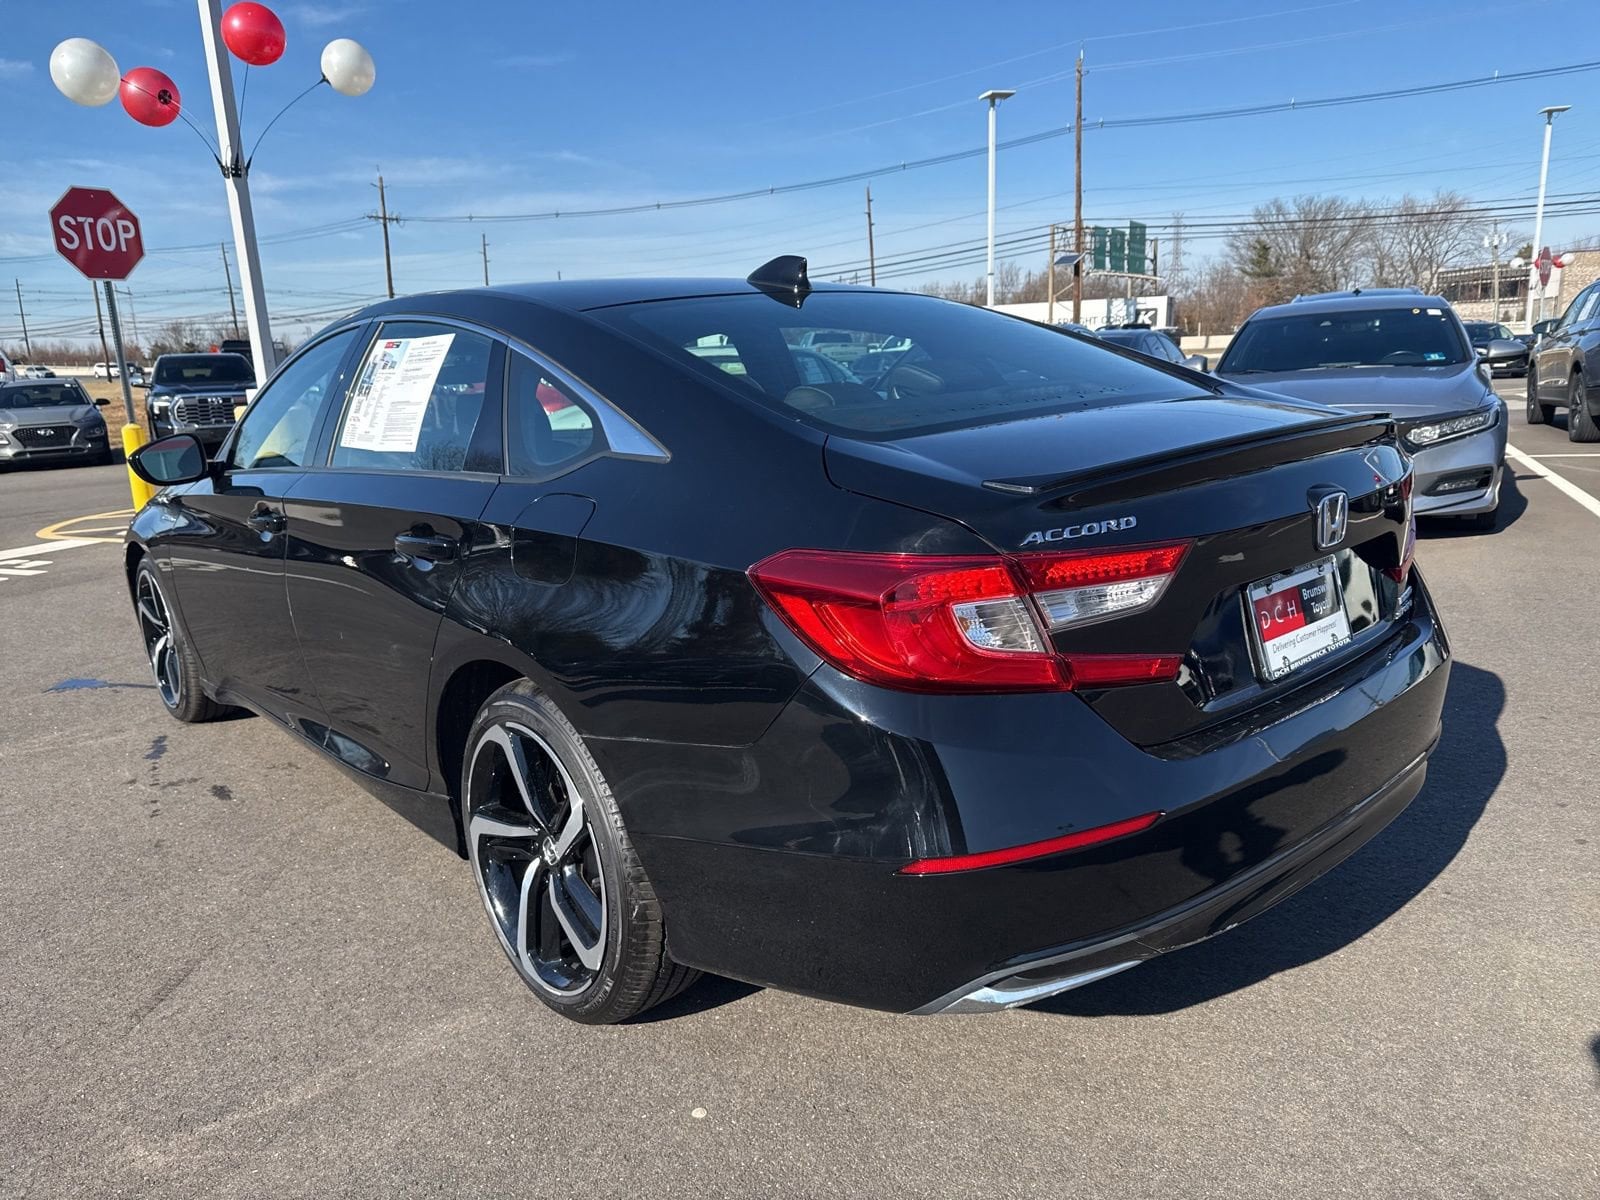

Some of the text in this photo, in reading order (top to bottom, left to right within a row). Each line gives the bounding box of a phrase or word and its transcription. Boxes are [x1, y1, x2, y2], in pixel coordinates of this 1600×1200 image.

[59, 215, 136, 252] STOP
[1057, 315, 1098, 326] FRGHT
[1020, 516, 1137, 546] ACCORD
[1302, 583, 1328, 601] Brunsw
[1311, 598, 1331, 614] Toyot
[1272, 638, 1296, 654] Delivering
[1296, 630, 1317, 643] Customer
[1274, 637, 1352, 678] DCH BRUNSWICK TOYOTA
